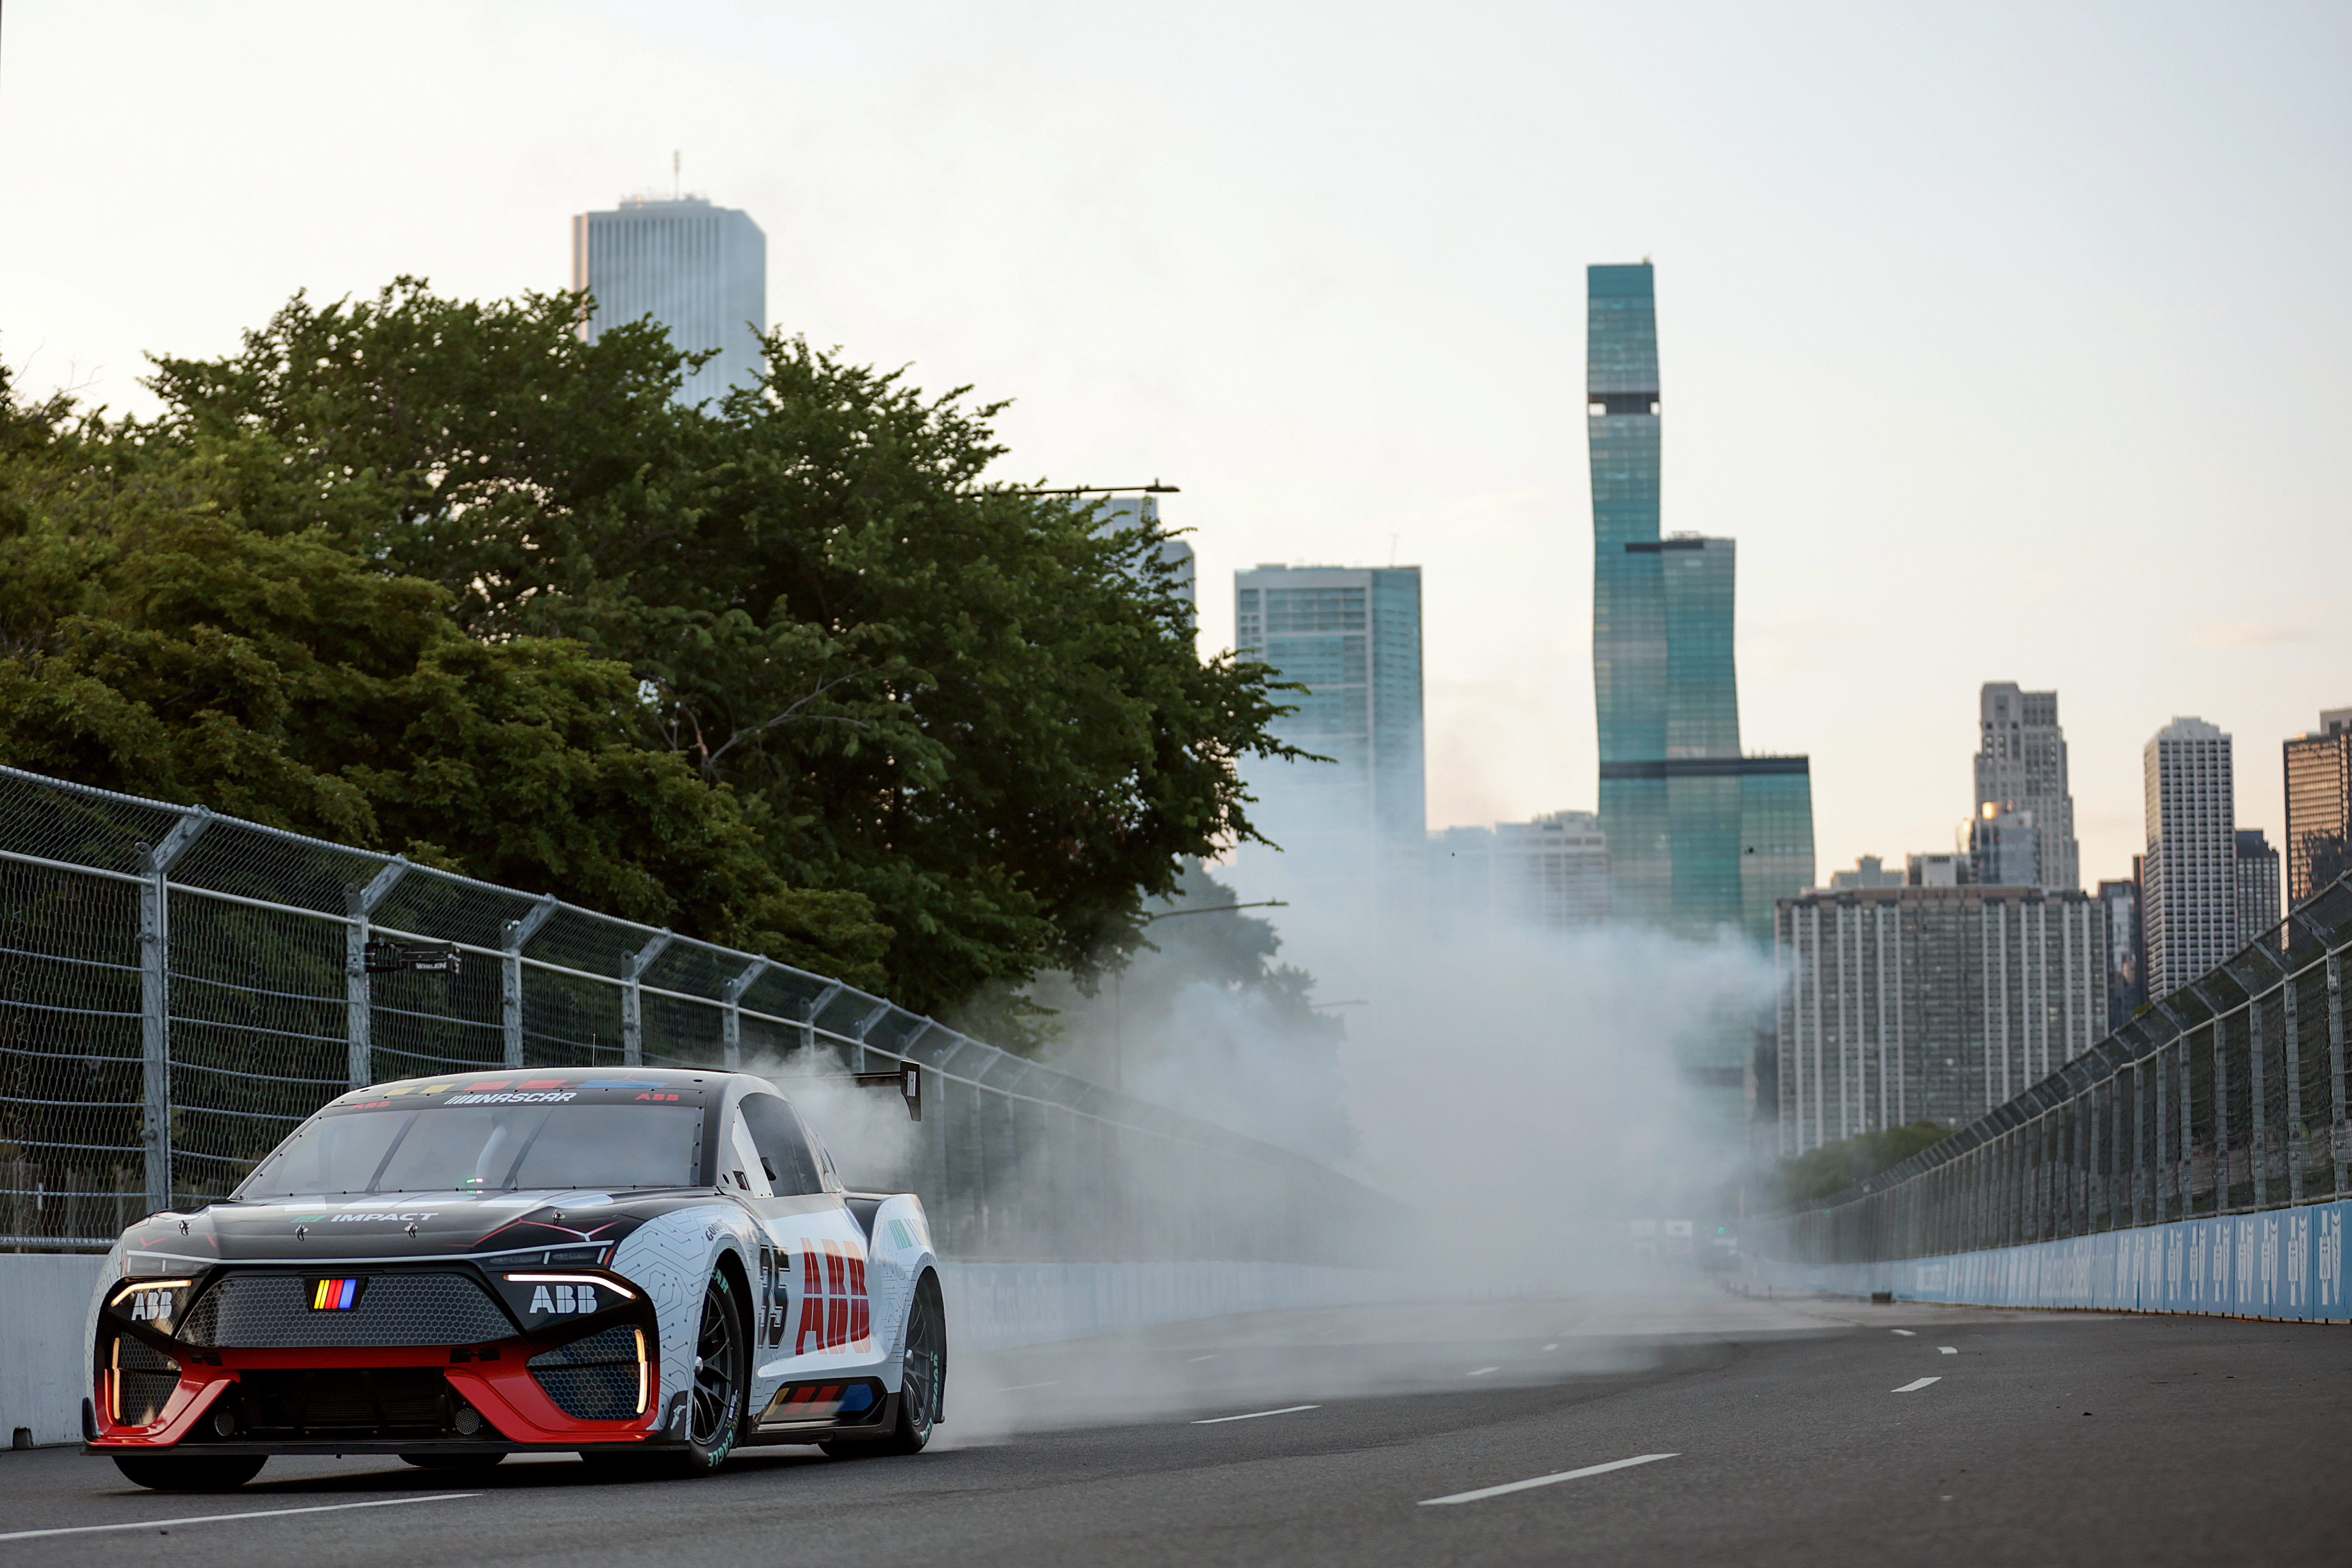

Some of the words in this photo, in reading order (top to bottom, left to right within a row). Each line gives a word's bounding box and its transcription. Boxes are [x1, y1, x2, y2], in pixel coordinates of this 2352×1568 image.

[348, 1100, 391, 1110] ABB
[473, 1092, 577, 1103] NASCAR
[634, 1093, 679, 1101] ABB
[330, 1213, 439, 1222] IMPACT
[131, 1291, 172, 1321] ABB
[529, 1285, 598, 1314] ABB
[796, 1237, 871, 1355] ABB
[707, 1429, 734, 1467] EAGLE
